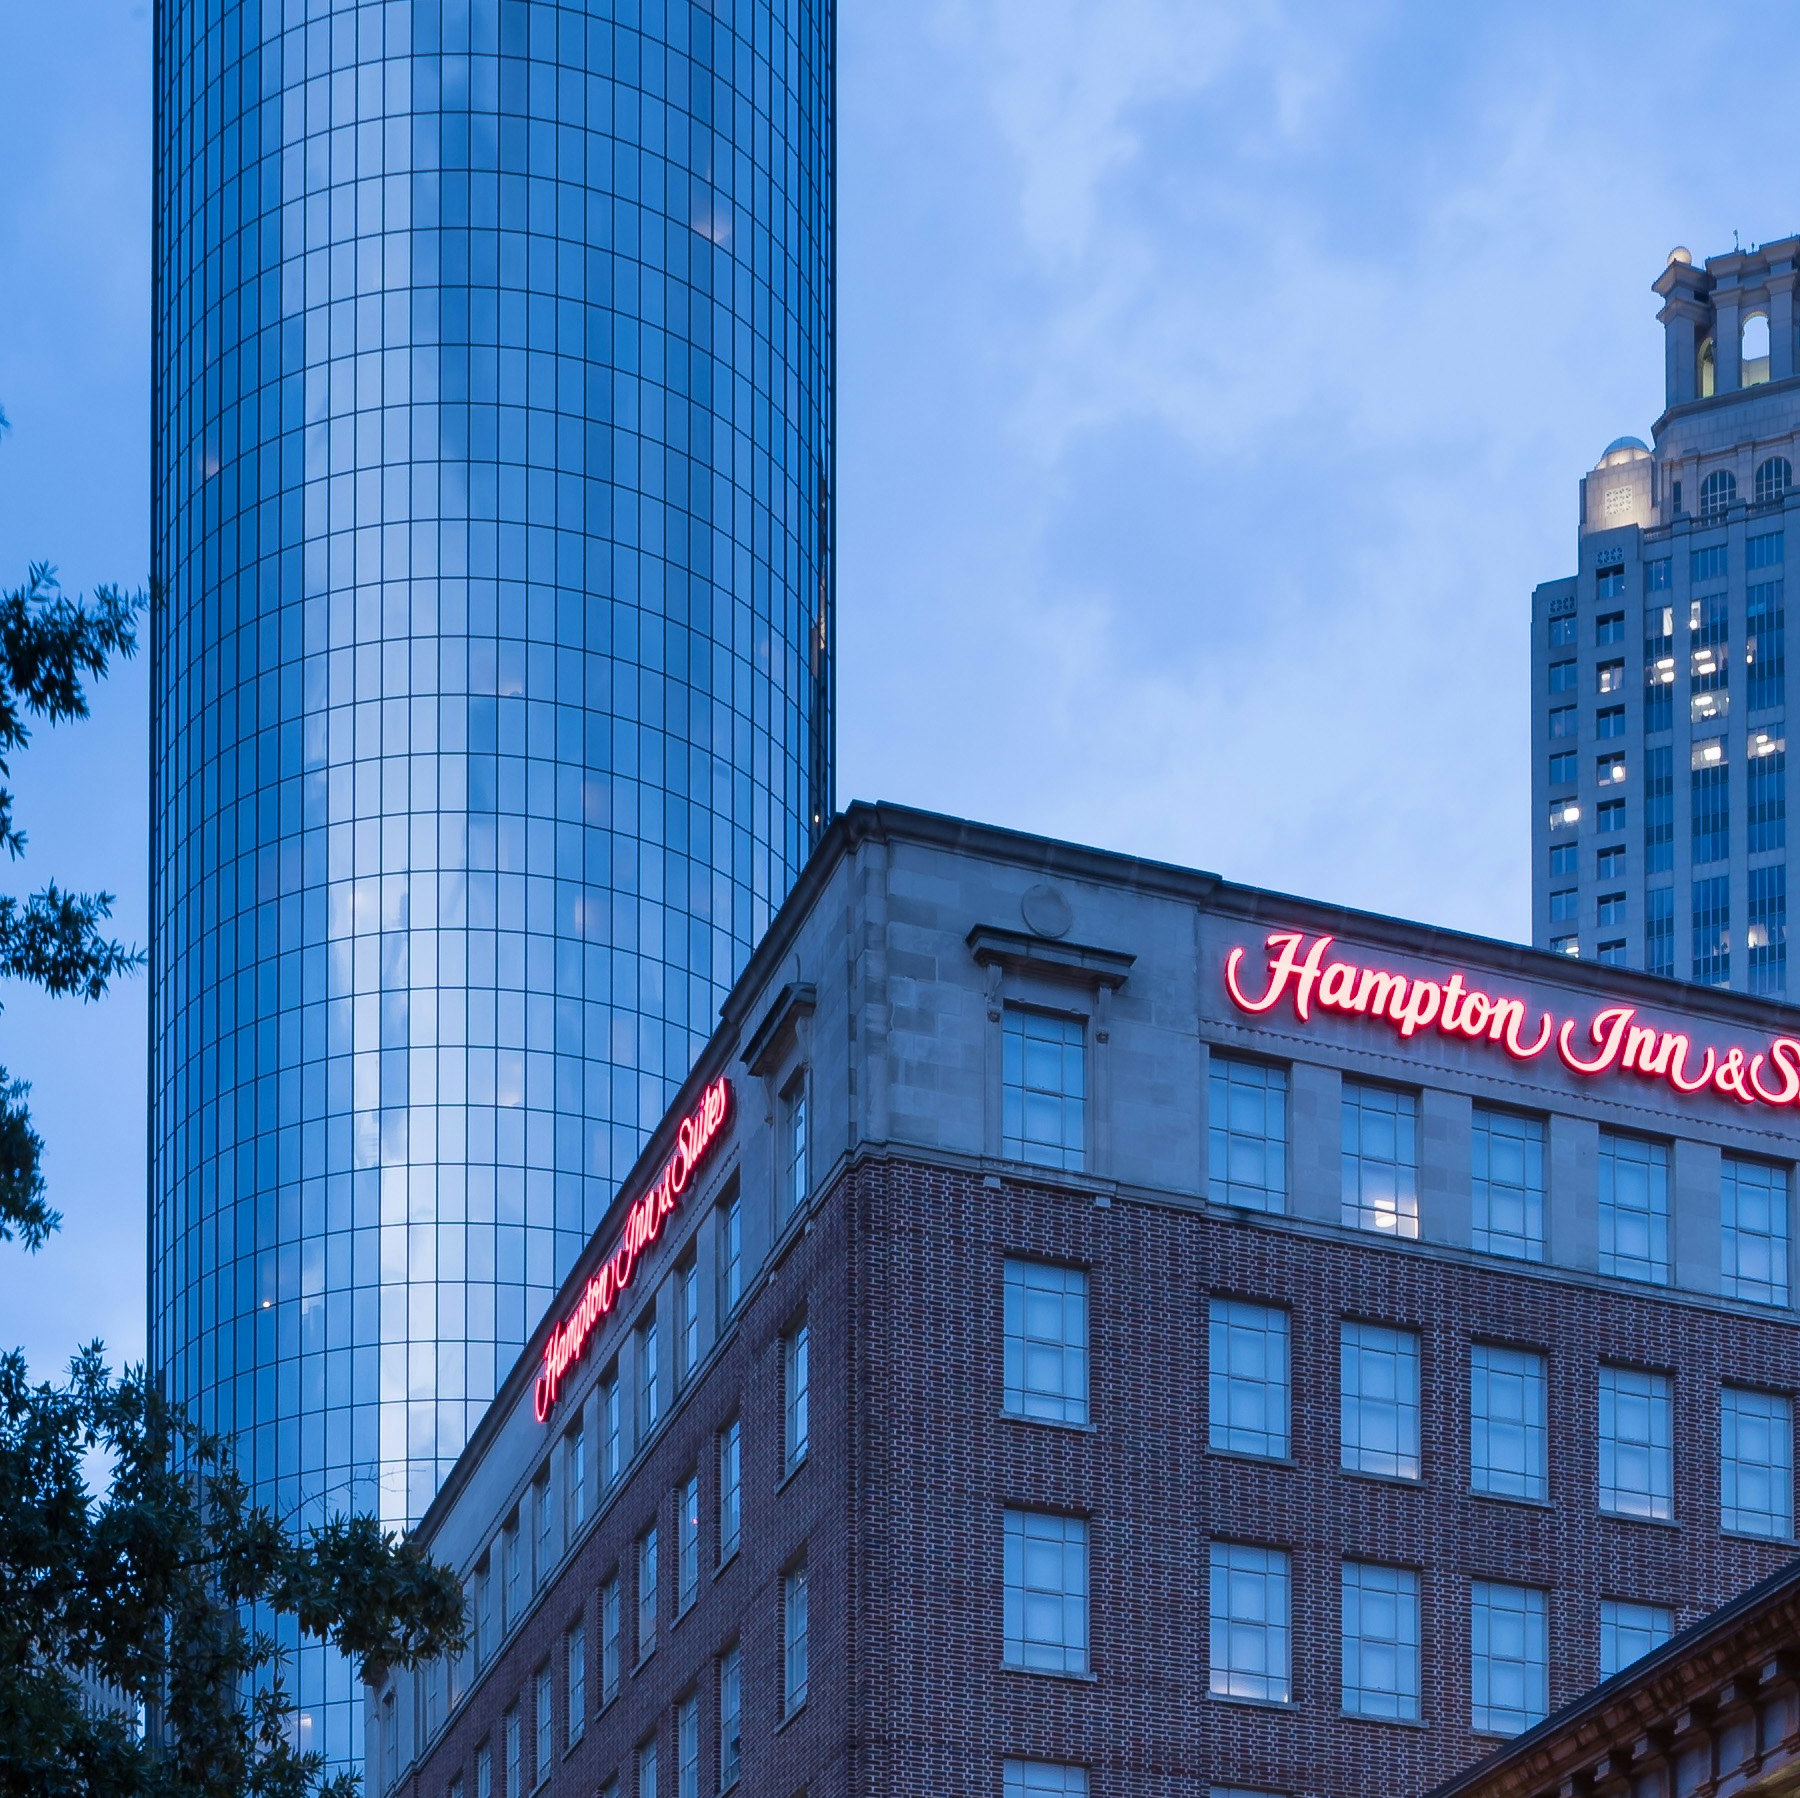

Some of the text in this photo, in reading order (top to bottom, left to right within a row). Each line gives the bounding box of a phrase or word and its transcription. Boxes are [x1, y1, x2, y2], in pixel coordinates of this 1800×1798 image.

[1225, 932, 1553, 1060] Hampton
[1560, 1007, 1715, 1095] Inn
[1715, 1048, 1755, 1102] &
[535, 1257, 618, 1422] Hampton
[672, 1075, 728, 1194] Suites
